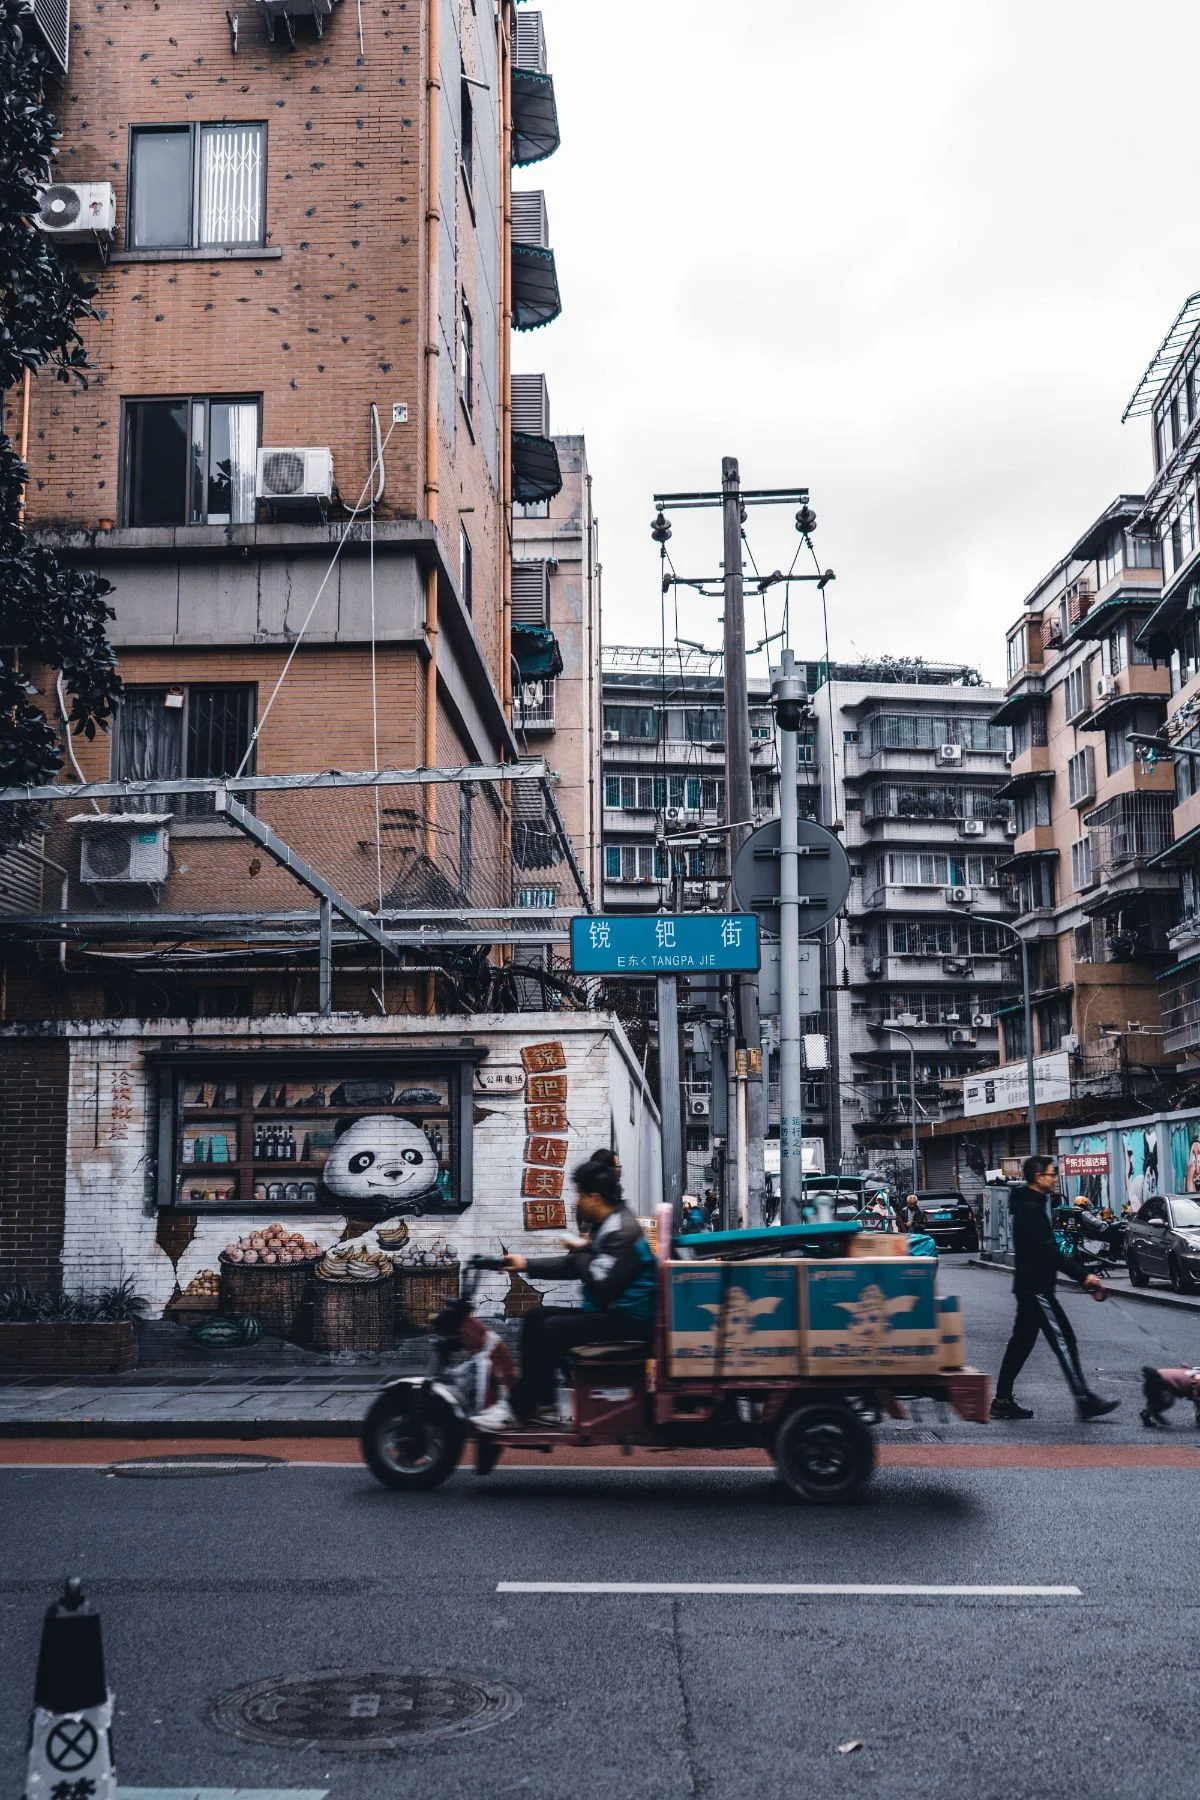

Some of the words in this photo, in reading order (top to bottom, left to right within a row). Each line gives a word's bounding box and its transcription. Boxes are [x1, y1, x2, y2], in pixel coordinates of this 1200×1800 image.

[589, 919, 742, 949] 镋钯街
[617, 956, 626, 967] E
[628, 955, 639, 967] 东
[651, 955, 695, 966] TANGPA
[699, 954, 716, 966] JIE
[486, 1074, 523, 1085] 公用电话
